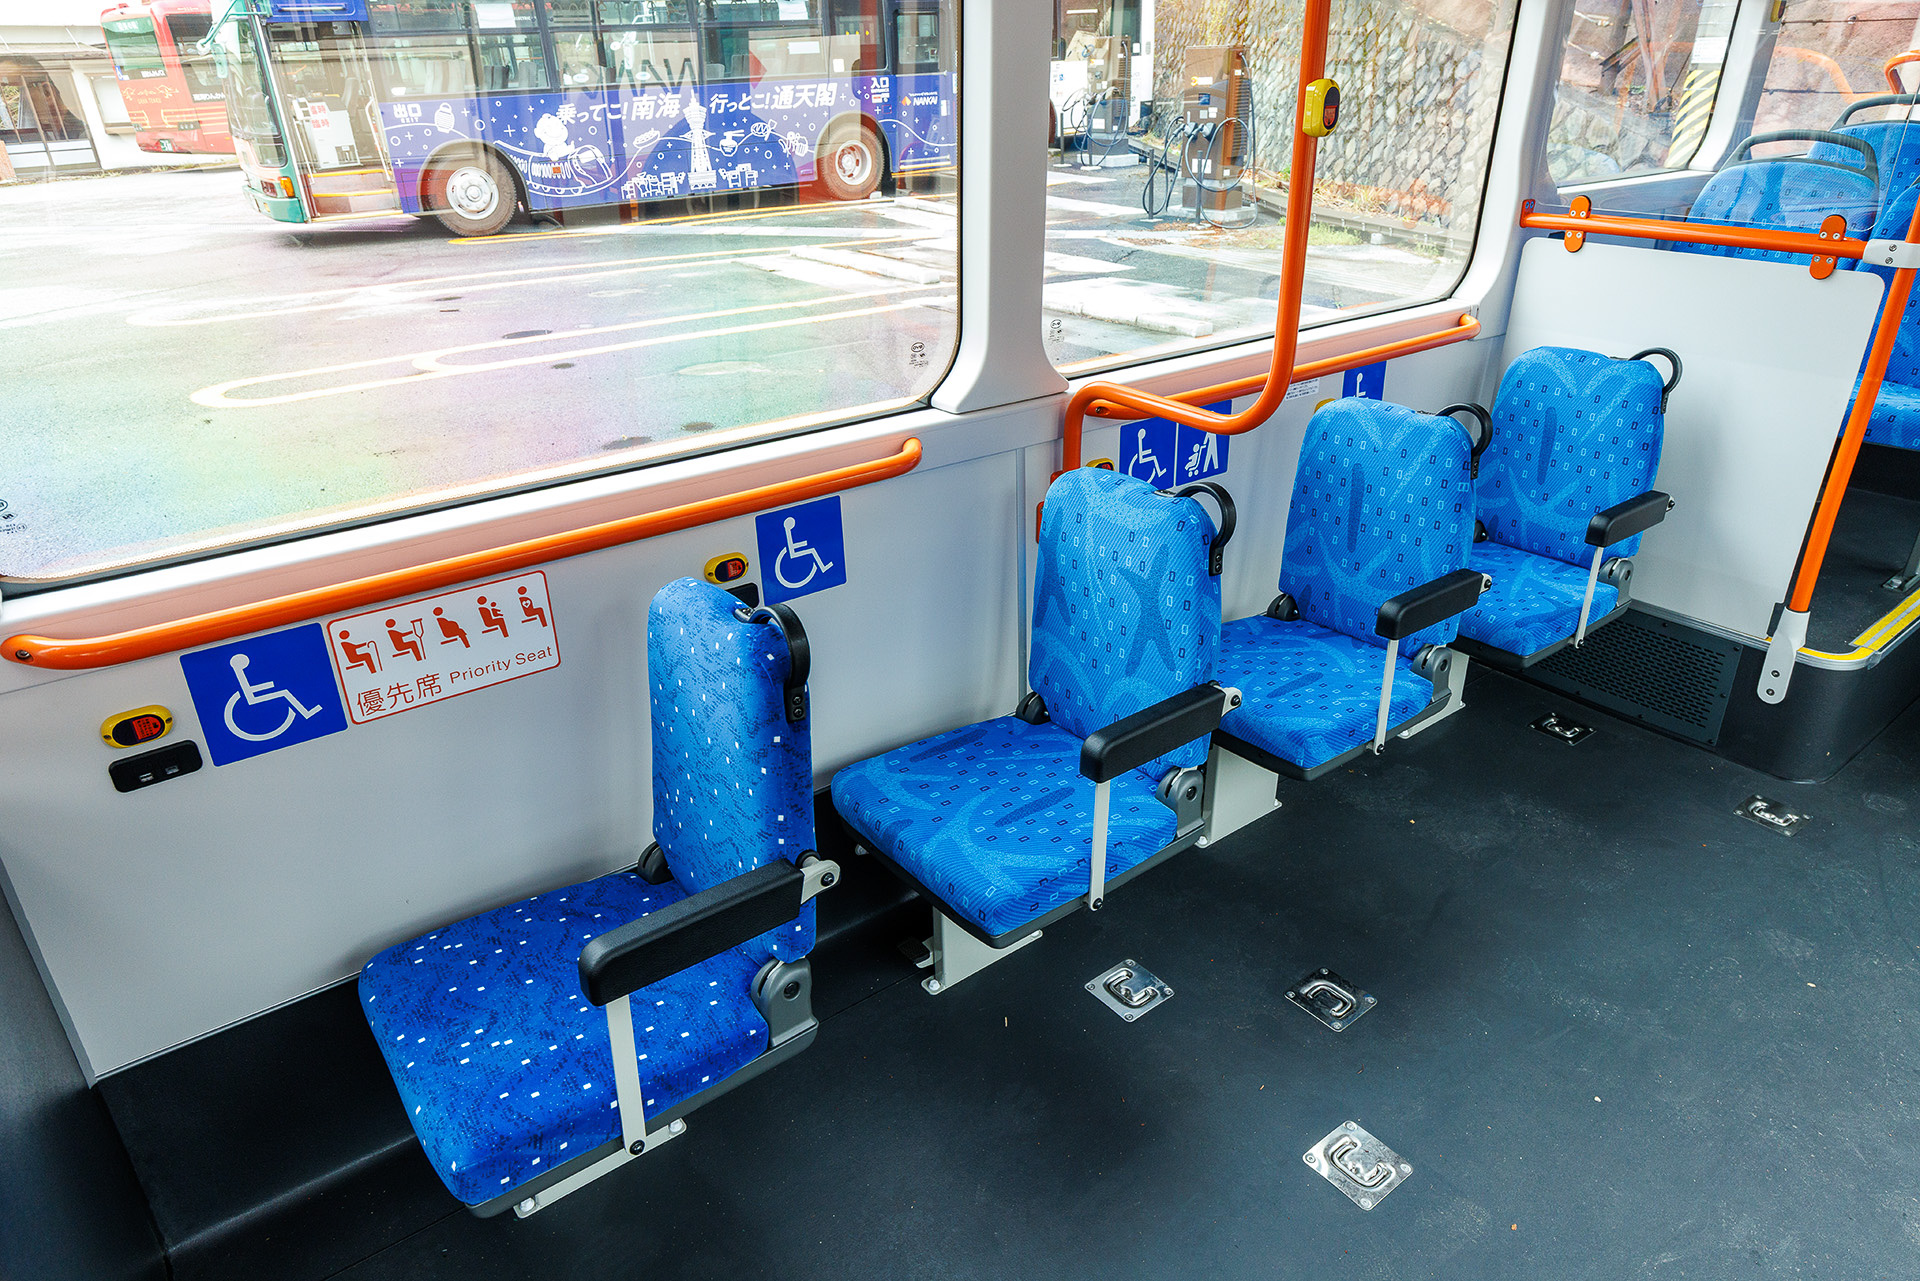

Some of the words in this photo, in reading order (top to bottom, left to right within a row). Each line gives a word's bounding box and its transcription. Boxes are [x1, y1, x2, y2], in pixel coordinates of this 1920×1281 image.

[870, 76, 890, 88] 入口
[912, 96, 938, 106] NANKAI
[393, 103, 422, 119] 出口
[449, 659, 511, 684] Priority
[515, 645, 553, 665] Seat
[357, 672, 442, 717] 優先席
